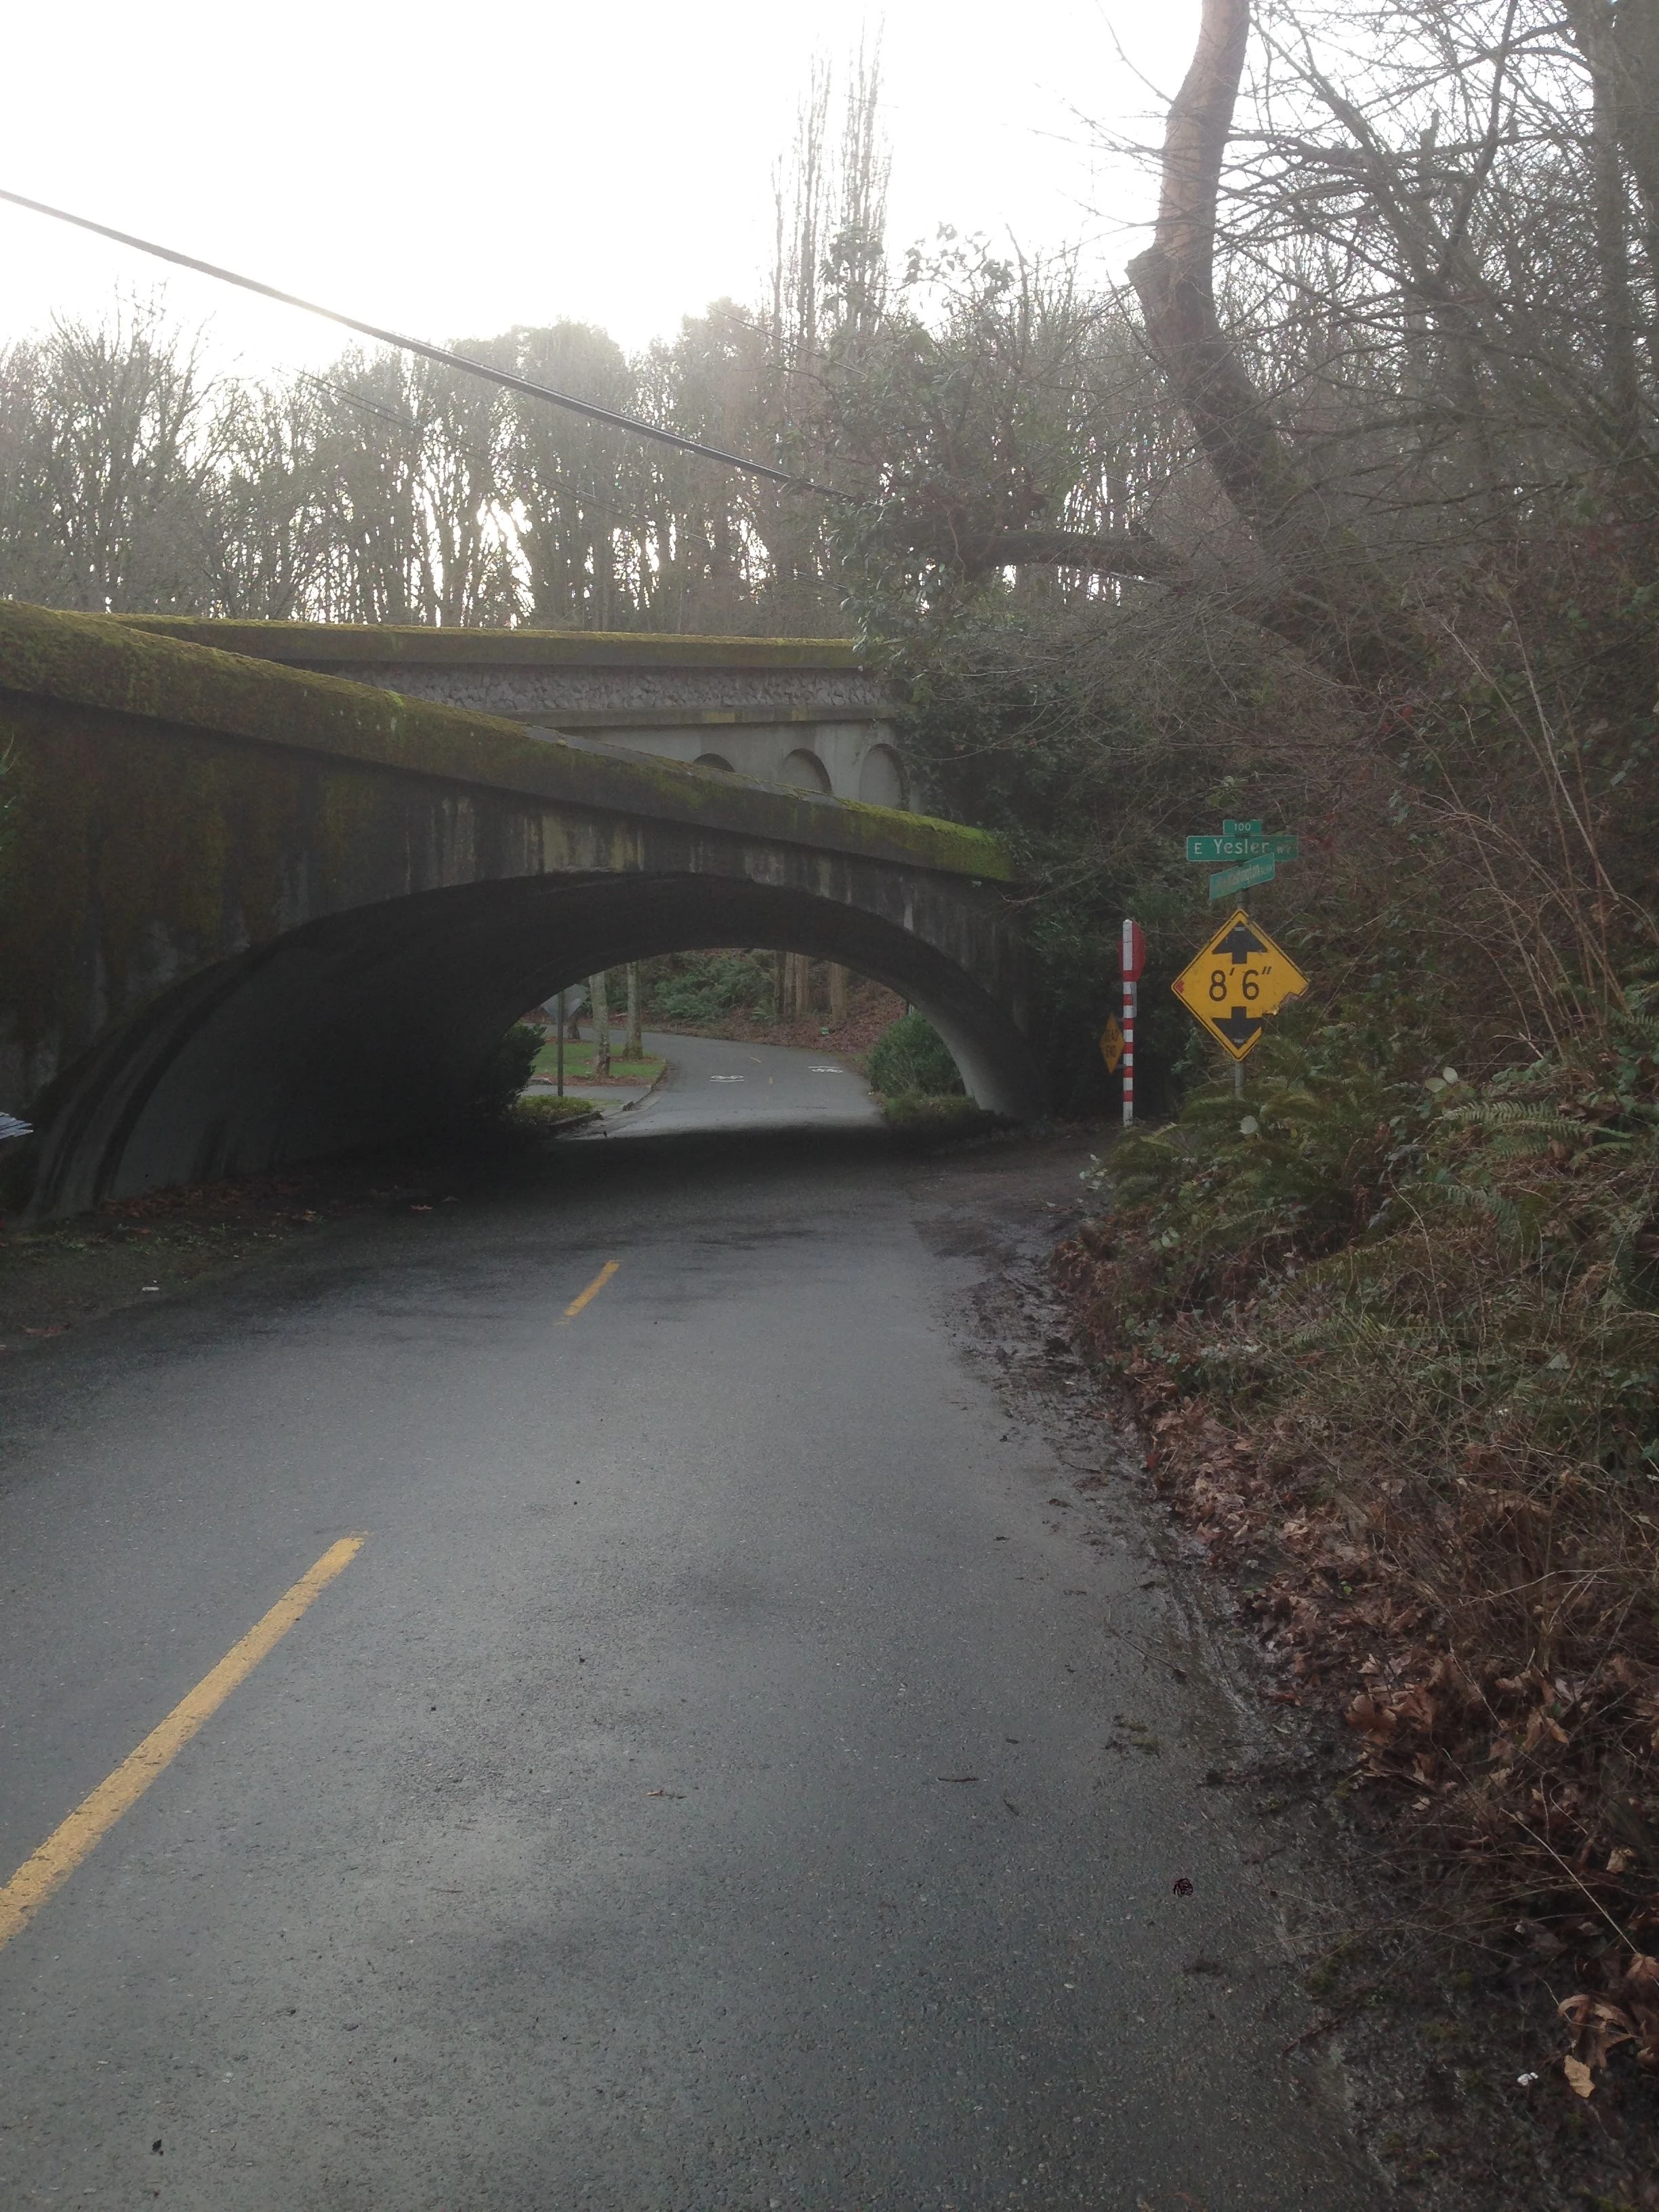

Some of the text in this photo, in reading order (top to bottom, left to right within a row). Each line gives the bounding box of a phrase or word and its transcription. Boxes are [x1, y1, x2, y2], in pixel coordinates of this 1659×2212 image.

[1234, 823, 1251, 831] 100
[1194, 842, 1202, 854] E
[1214, 838, 1269, 854] Yesler
